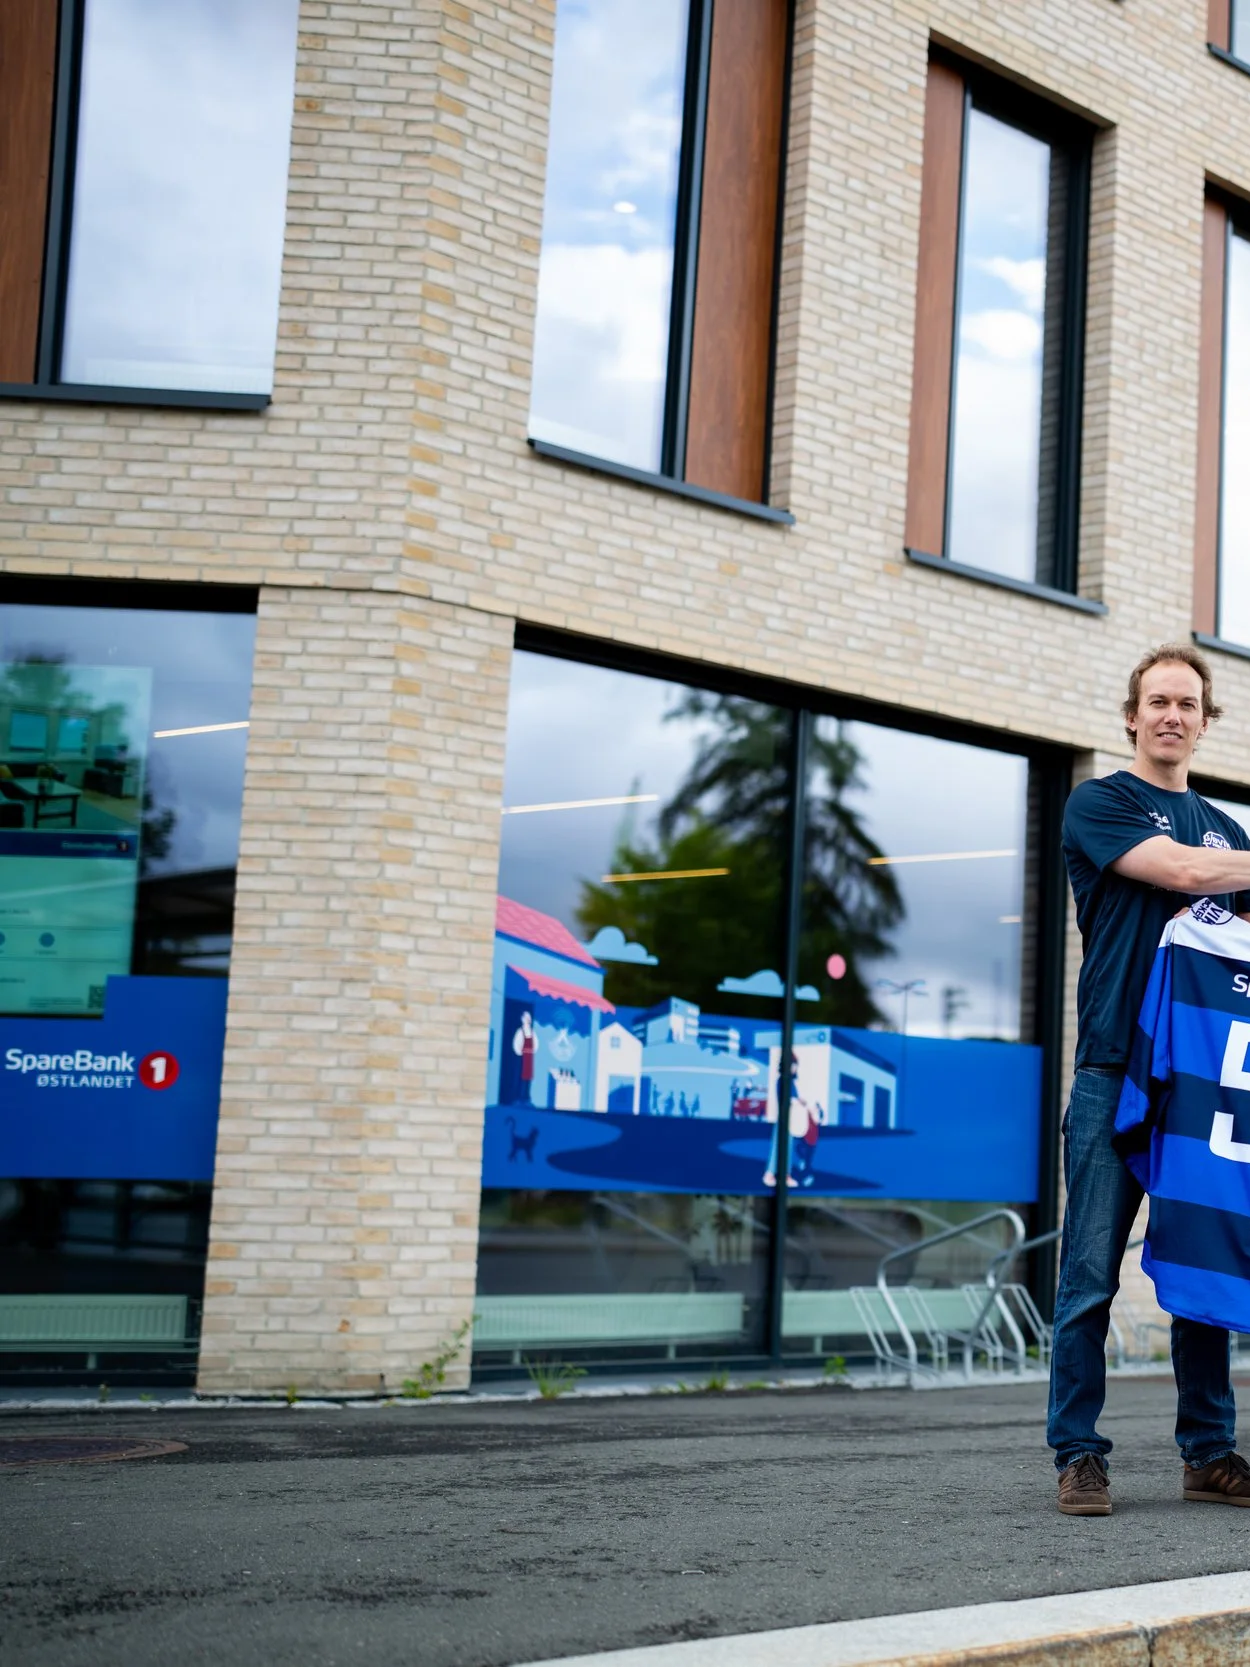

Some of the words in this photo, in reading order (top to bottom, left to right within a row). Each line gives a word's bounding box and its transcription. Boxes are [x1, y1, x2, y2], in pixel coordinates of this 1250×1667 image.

[5, 1048, 136, 1074] SpareBank
[150, 1057, 167, 1084] 1
[36, 1074, 136, 1088] ØSTLANDET
